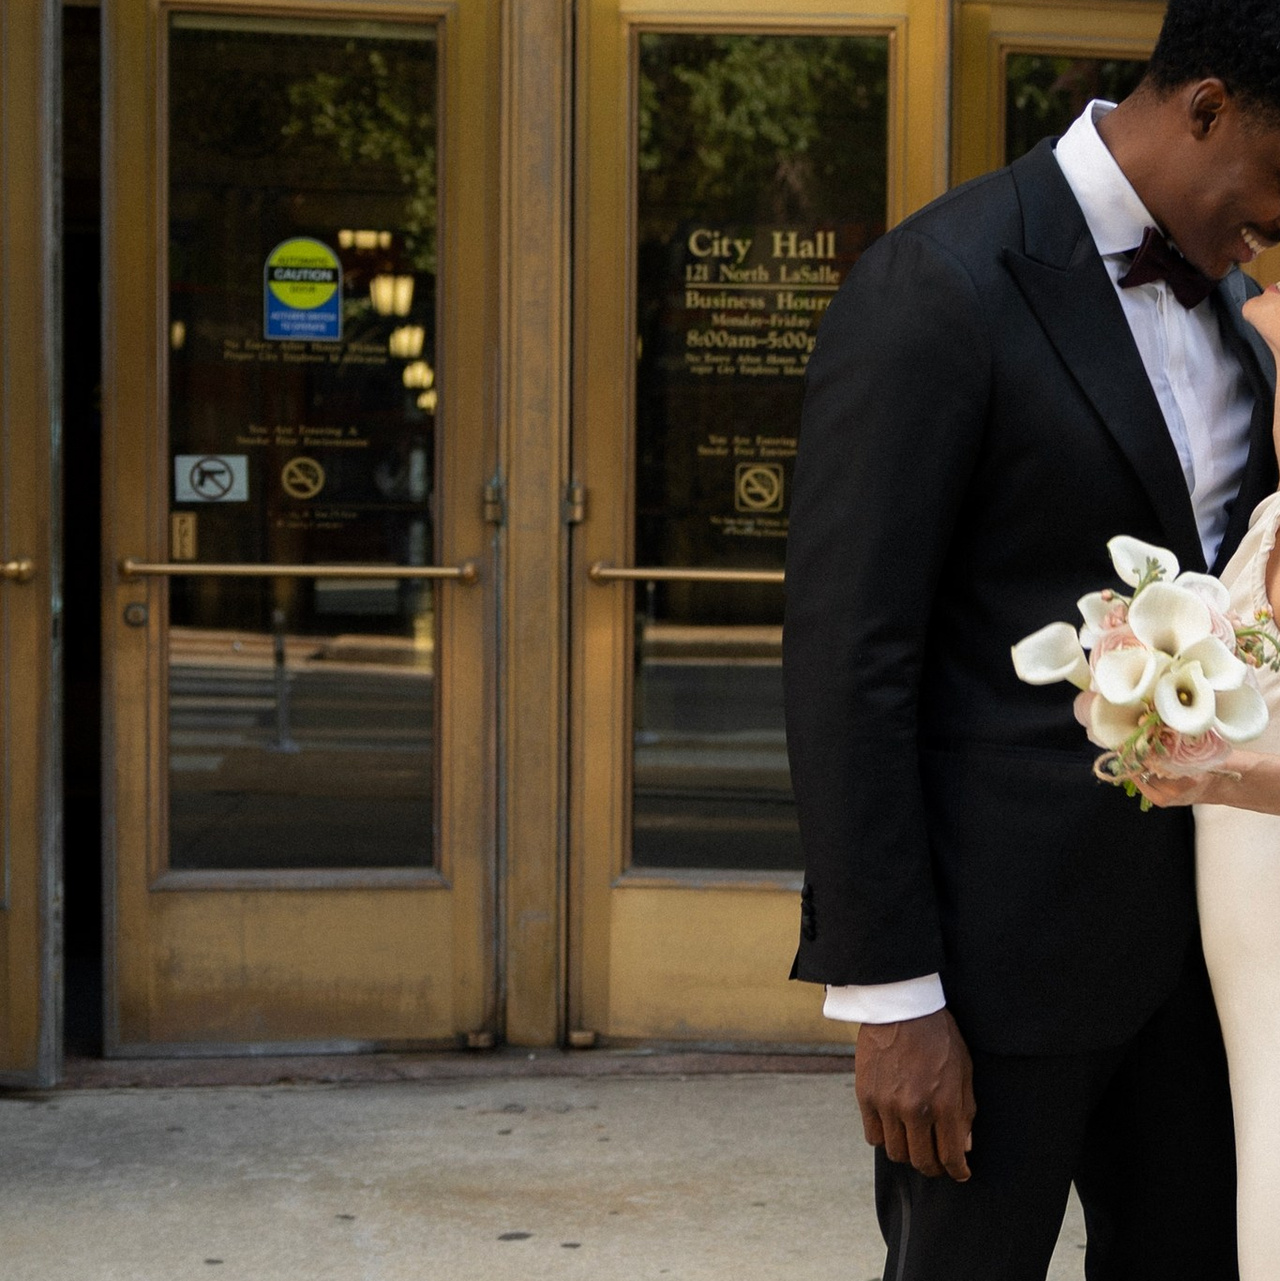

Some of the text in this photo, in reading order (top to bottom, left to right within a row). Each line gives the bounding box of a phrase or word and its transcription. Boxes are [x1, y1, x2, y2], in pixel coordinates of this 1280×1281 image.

[689, 229, 836, 263] City Hall
[274, 268, 333, 280] CAUTION
[686, 264, 840, 283] 121 North LaSalle
[686, 291, 765, 309] Business
[686, 329, 816, 353] 8:00am-5:00p
